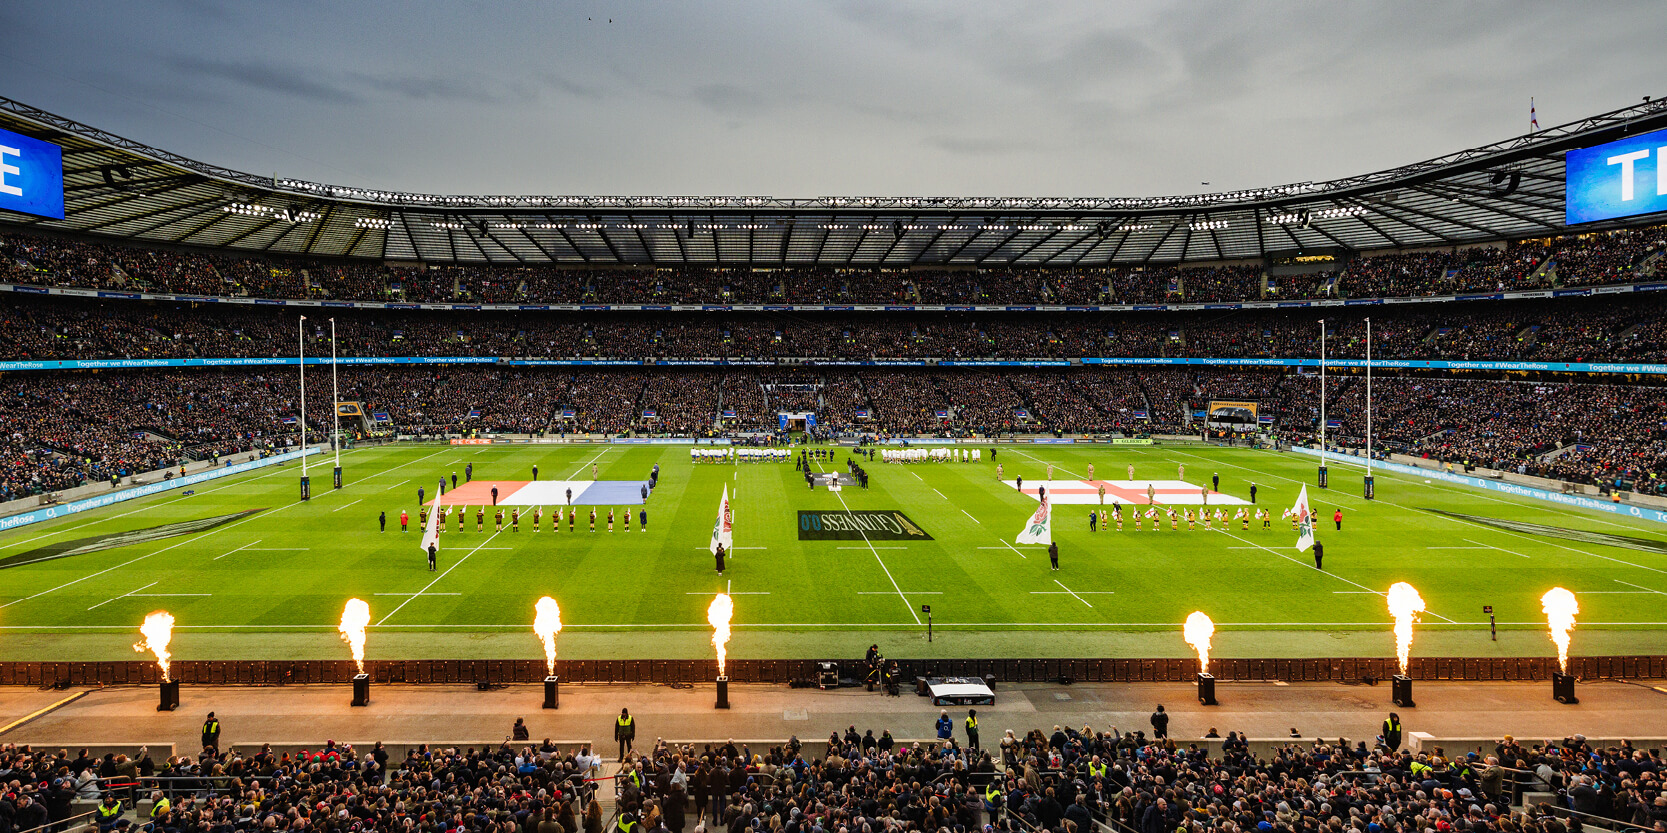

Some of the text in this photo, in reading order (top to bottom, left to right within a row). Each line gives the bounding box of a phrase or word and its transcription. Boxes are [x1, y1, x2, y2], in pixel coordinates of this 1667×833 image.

[77, 360, 108, 368] Together
[1447, 361, 1480, 369] Together
[1588, 363, 1625, 373] Together
[183, 473, 208, 484] Together
[67, 484, 163, 513] Together we #WearTheRose
[1495, 482, 1617, 512] Together we #WearTheRose
[46, 507, 57, 518] O2
[821, 513, 903, 534] GUINNESS
